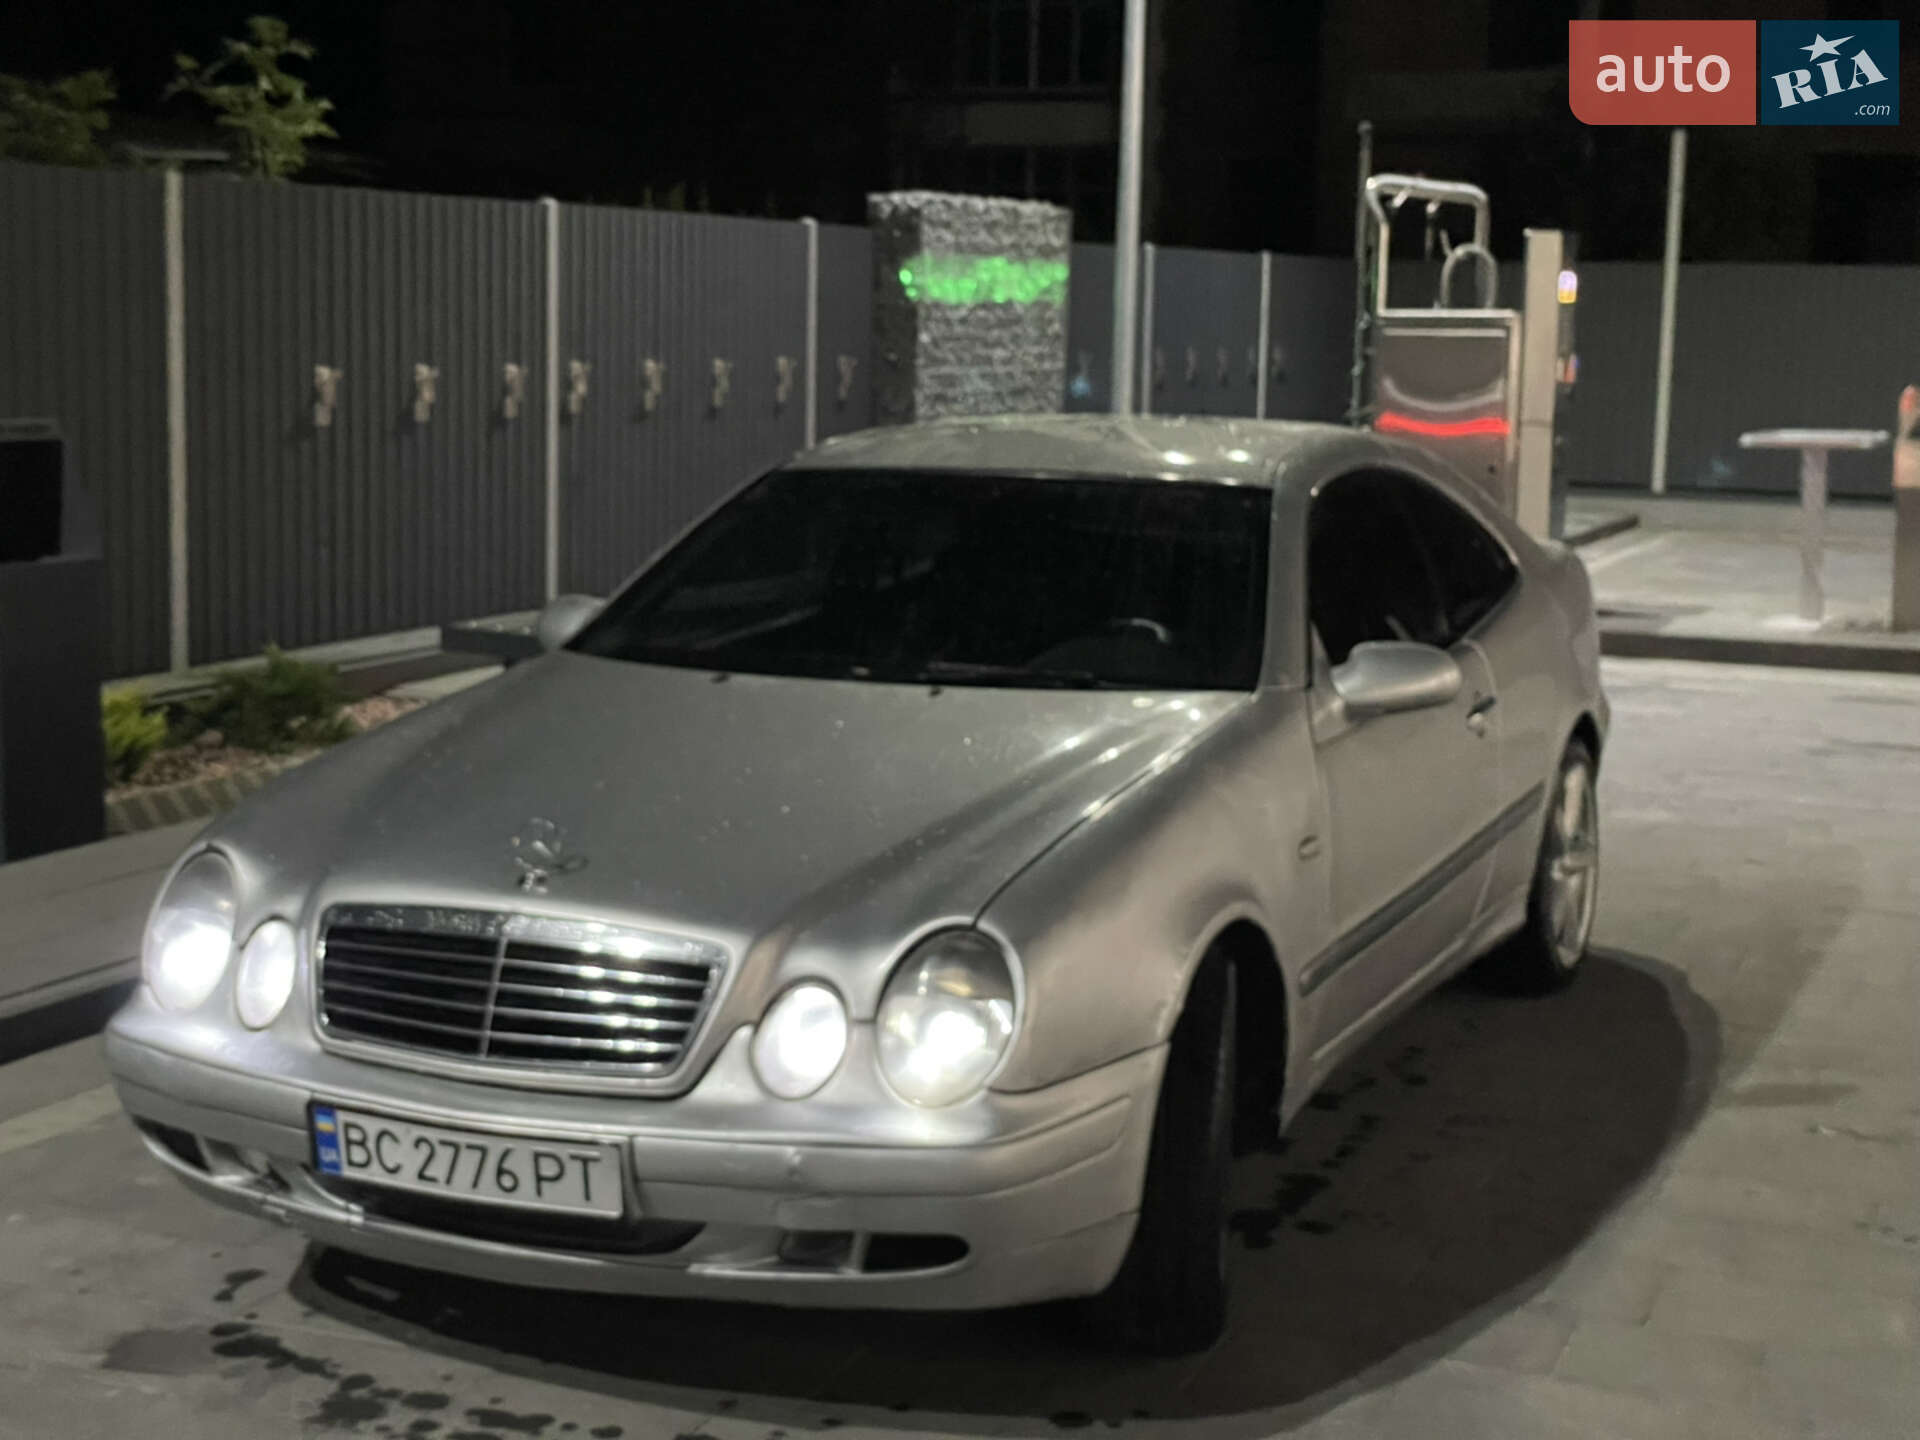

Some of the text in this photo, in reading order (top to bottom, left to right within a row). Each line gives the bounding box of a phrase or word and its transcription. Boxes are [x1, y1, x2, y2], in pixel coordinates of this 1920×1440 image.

[343, 1122, 602, 1202] BC 2776 PT
